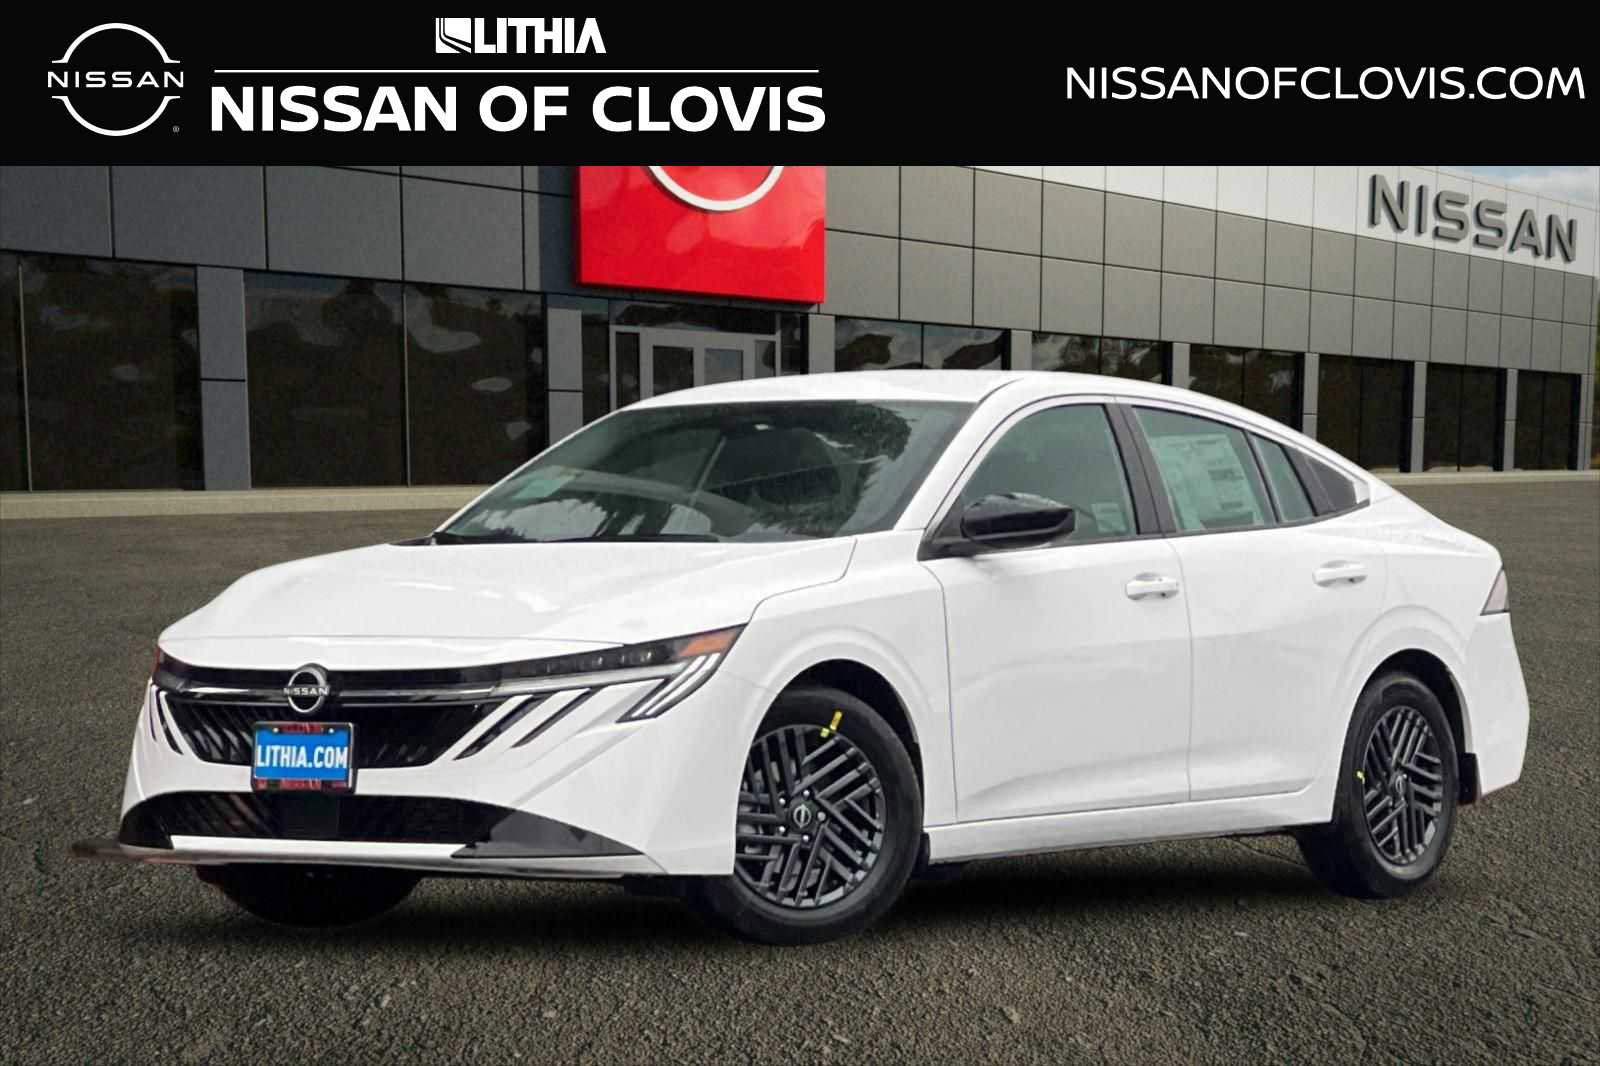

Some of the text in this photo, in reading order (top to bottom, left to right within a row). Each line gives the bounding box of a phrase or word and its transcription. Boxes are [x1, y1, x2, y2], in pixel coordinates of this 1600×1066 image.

[1368, 173, 1578, 263] NISSAN
[283, 686, 330, 697] NISSAN
[256, 744, 349, 769] LITHIA.COM
